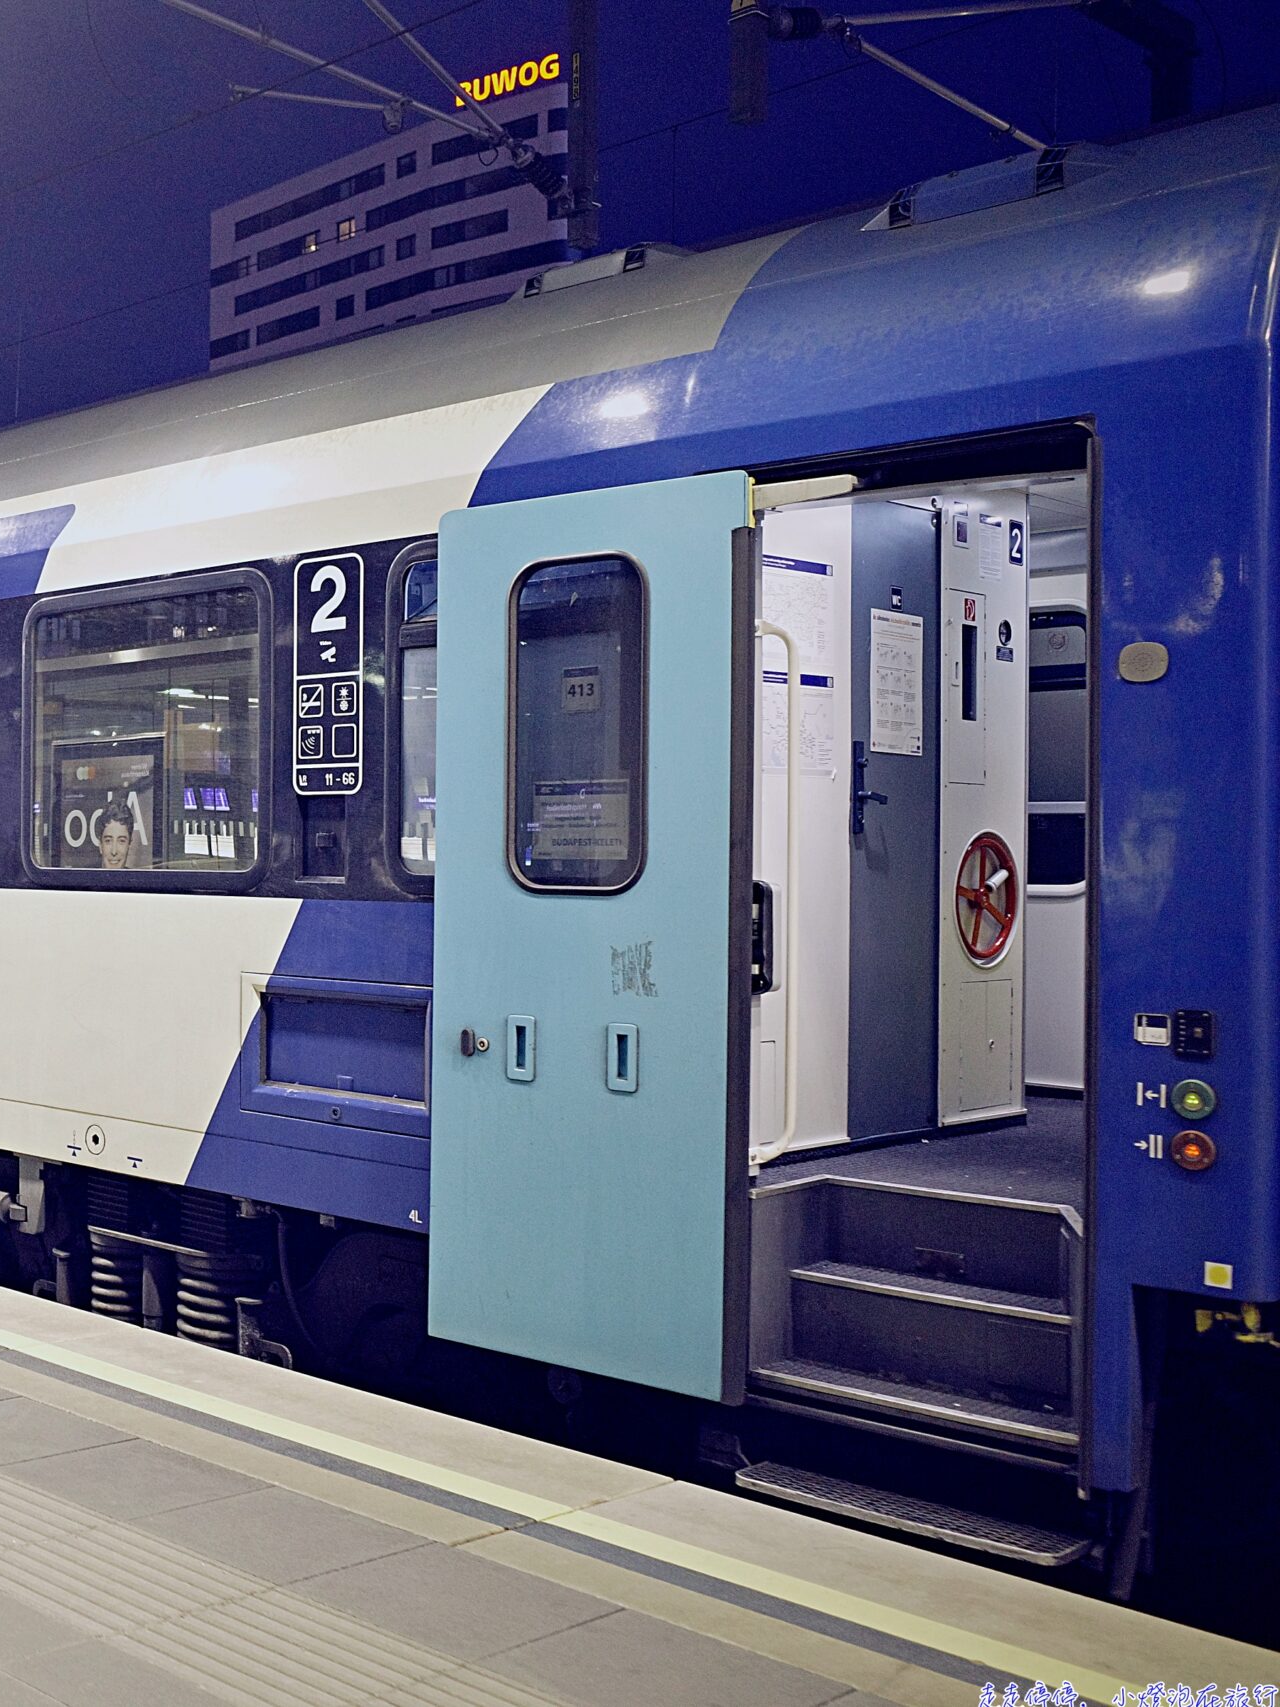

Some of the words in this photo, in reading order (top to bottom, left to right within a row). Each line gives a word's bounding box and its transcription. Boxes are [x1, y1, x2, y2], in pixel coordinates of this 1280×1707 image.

[1011, 528, 1022, 558] 2
[310, 565, 347, 633] 2
[567, 682, 595, 697] 413
[408, 1209, 423, 1224] 4L
